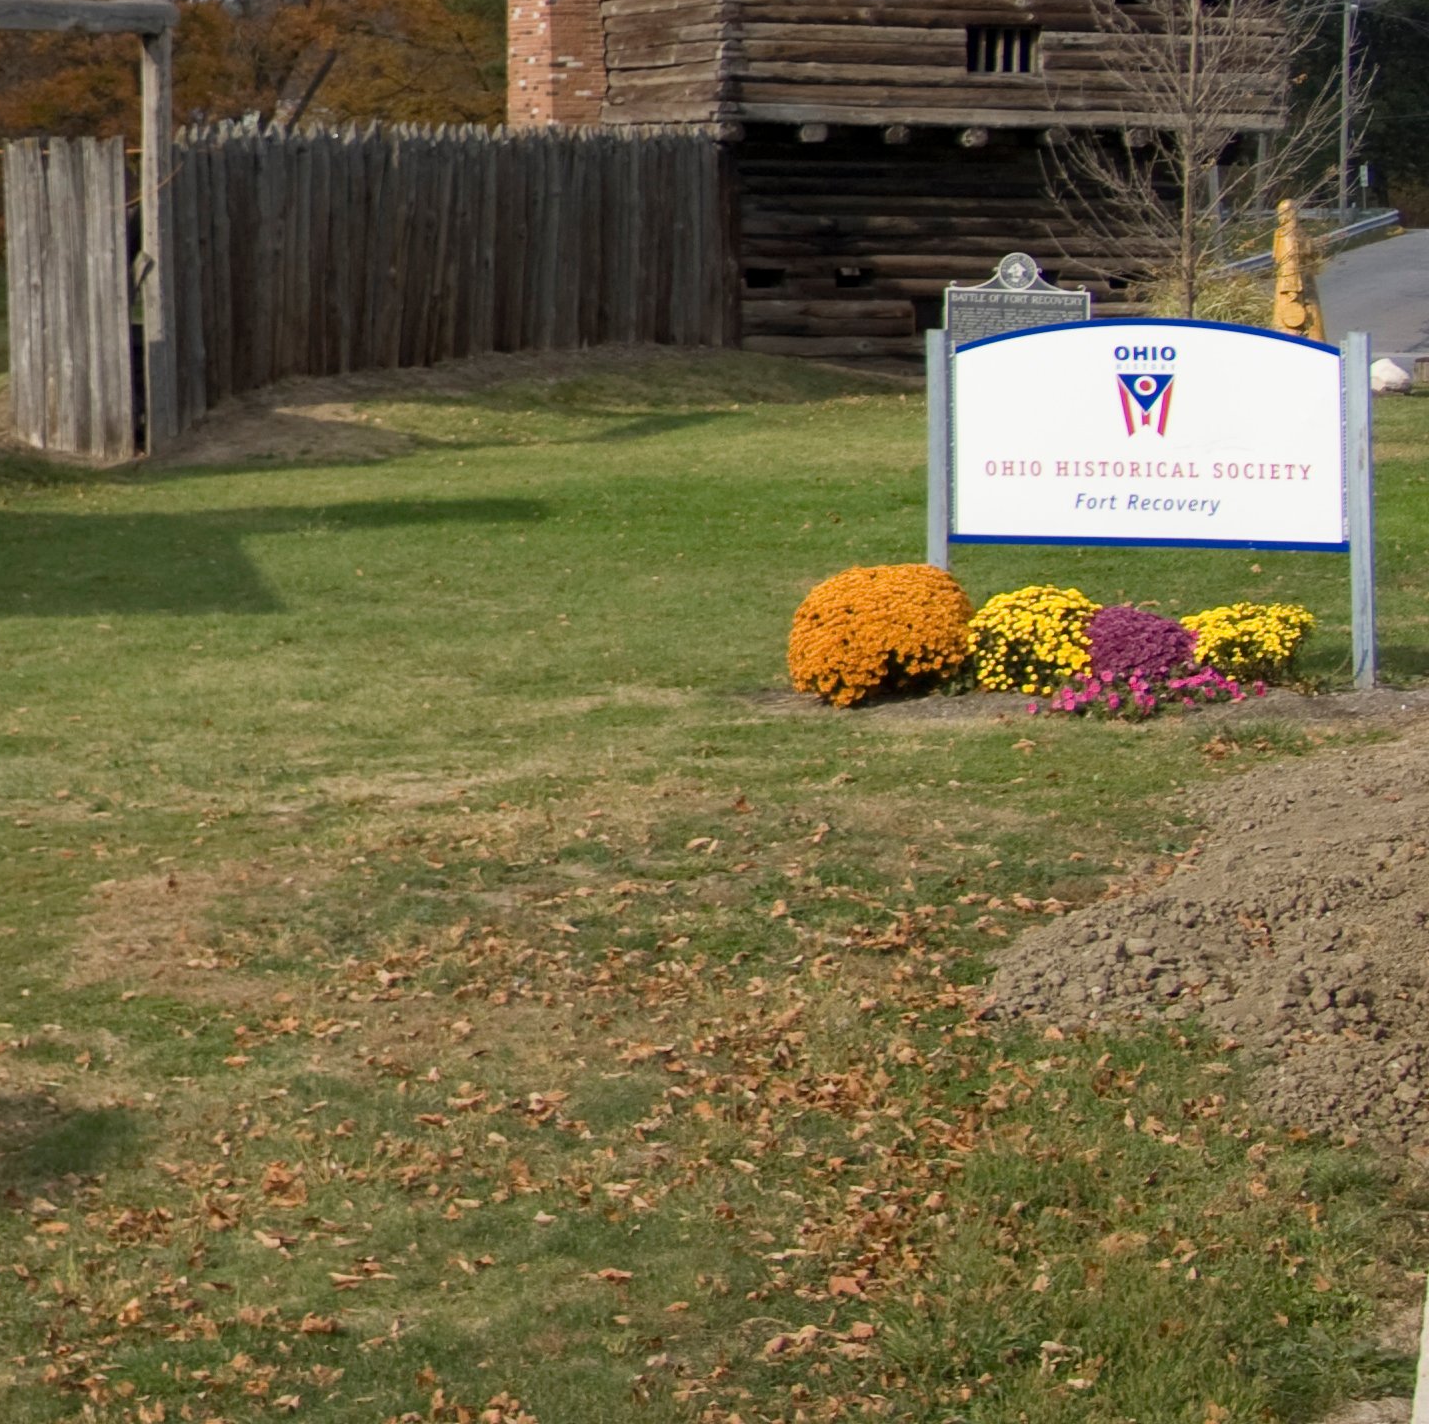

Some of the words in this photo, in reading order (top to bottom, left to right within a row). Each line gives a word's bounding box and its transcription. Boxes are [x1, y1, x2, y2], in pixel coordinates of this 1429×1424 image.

[951, 293, 986, 302] BATTLE
[990, 294, 1001, 303] OF
[1004, 294, 1029, 303] FORT
[1031, 295, 1083, 306] RECOVERY
[1114, 346, 1176, 361] OHIO
[985, 460, 1042, 477] OHIO
[1055, 460, 1200, 478] HISTORICAL
[1213, 462, 1312, 480] SOCIETY
[1075, 493, 1118, 510] Fort
[1127, 494, 1221, 516] Recovery
